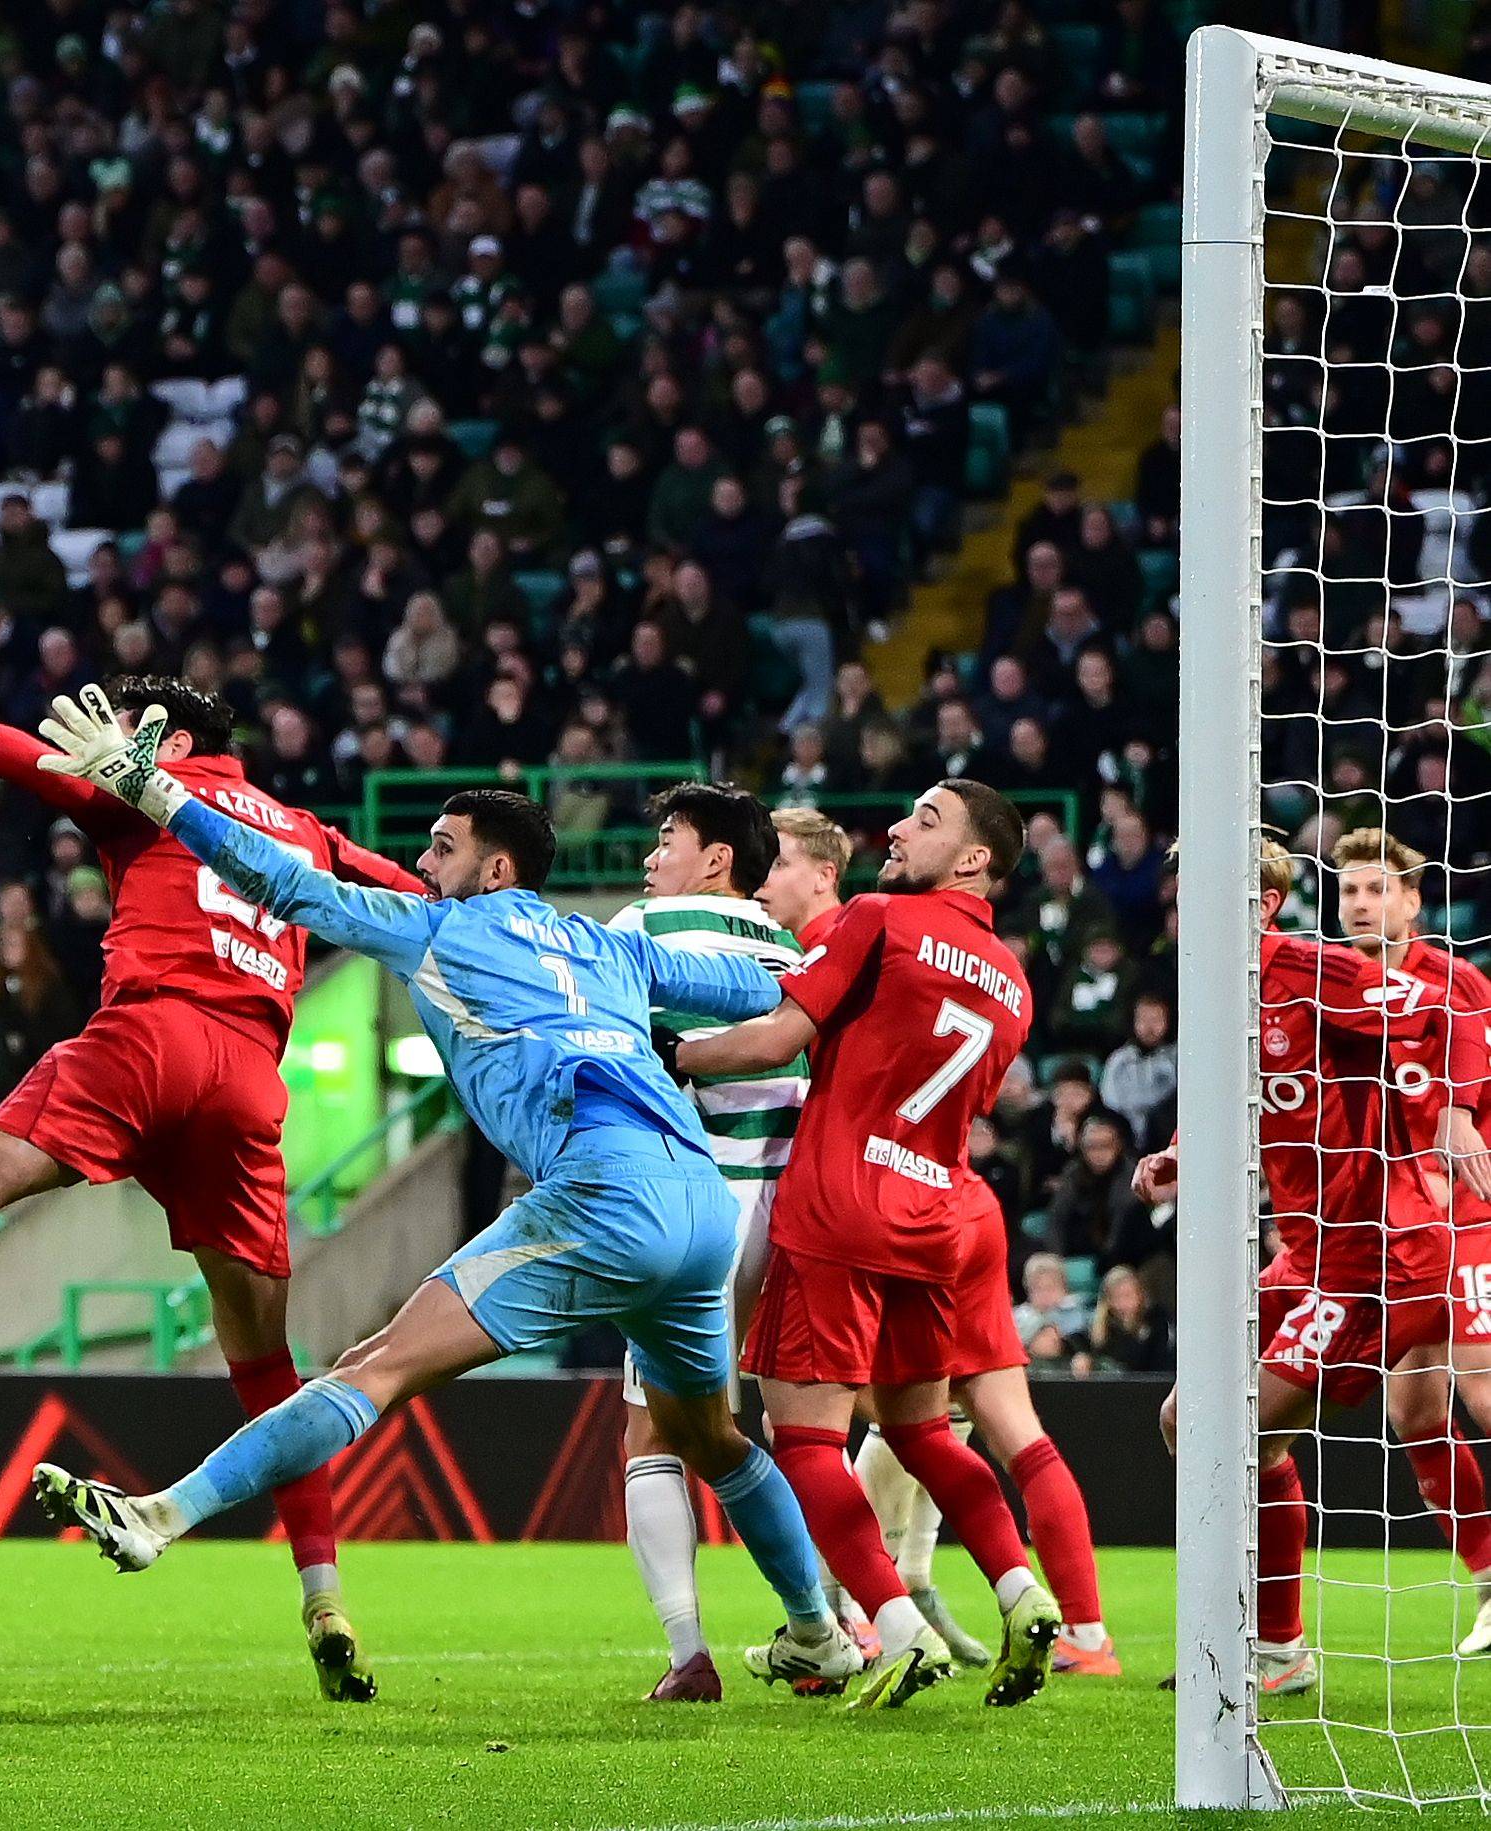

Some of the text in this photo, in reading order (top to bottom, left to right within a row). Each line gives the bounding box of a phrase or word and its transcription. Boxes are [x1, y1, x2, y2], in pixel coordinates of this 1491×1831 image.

[84, 691, 113, 725] ONE
[199, 787, 294, 831] AZETIC
[538, 954, 588, 1017] 1
[916, 934, 1024, 1019] AOUCHICHE
[895, 996, 995, 1125] 7
[1278, 1291, 1347, 1353] 28
